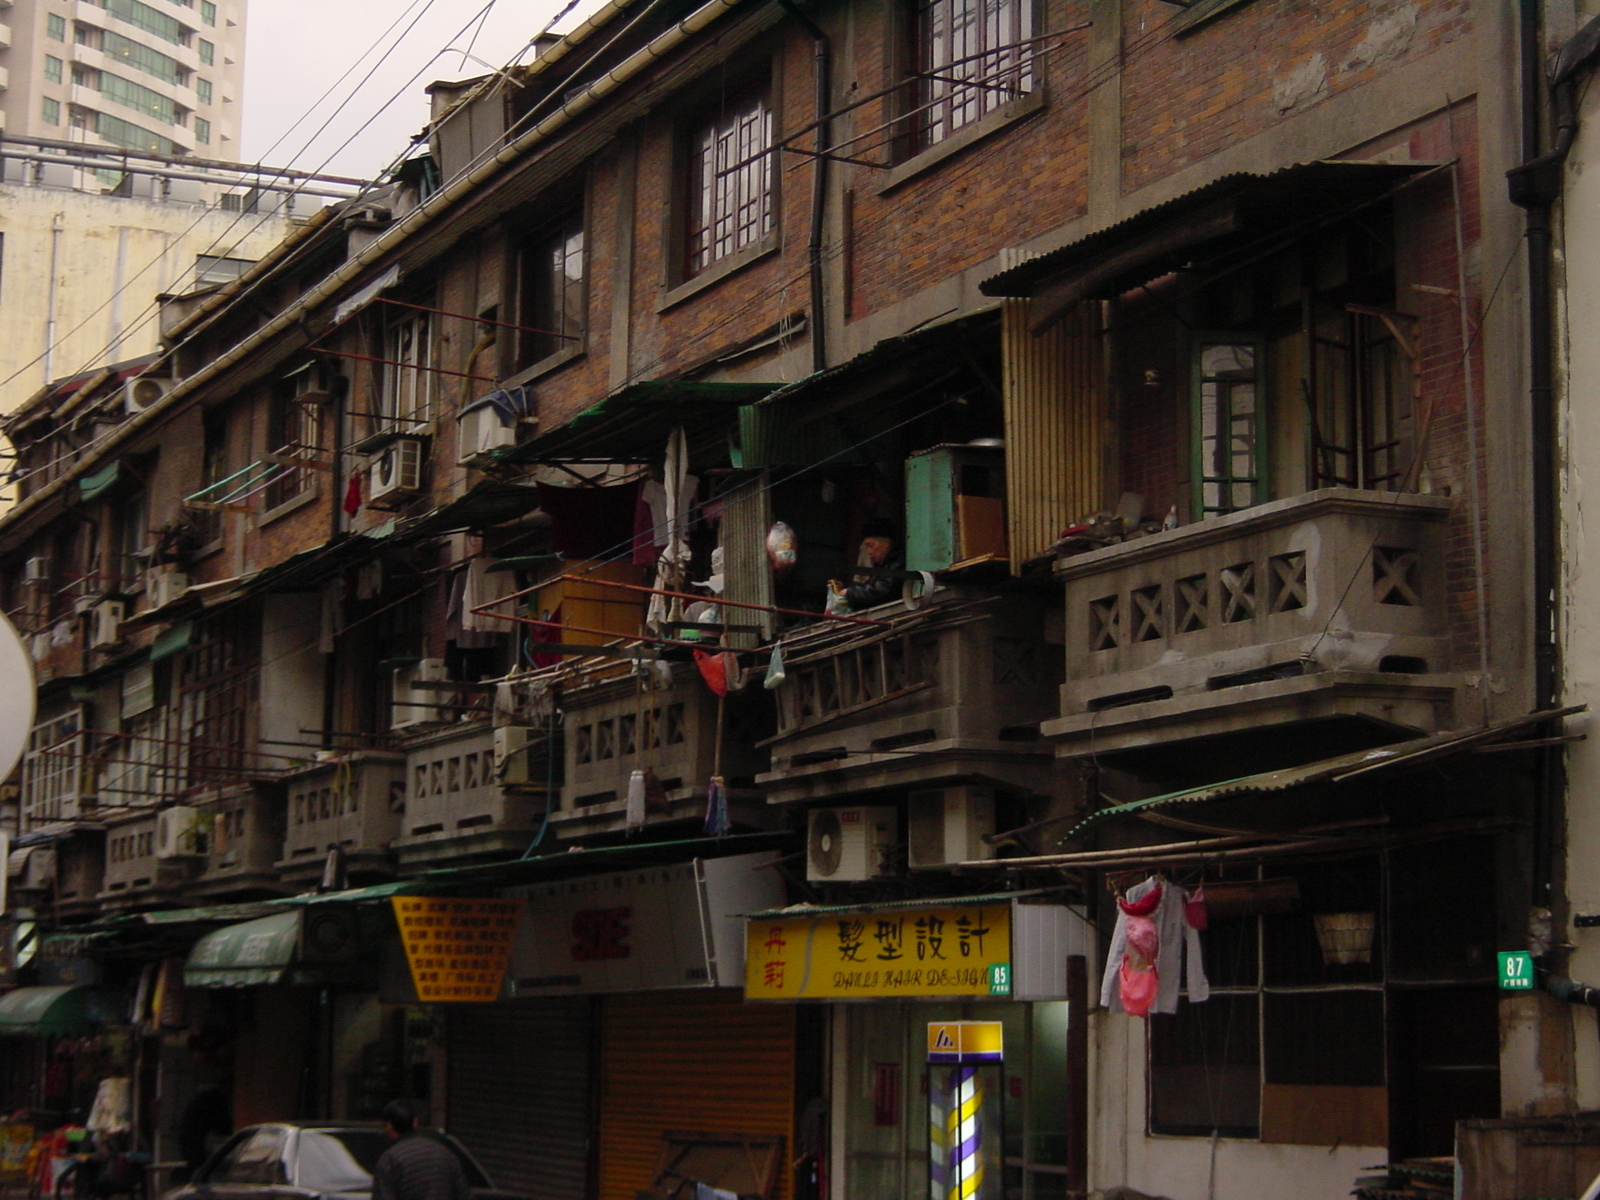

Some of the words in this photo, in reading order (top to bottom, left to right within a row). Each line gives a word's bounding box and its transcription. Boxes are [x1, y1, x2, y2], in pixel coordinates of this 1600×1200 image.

[837, 910, 990, 962] 髮型設計
[994, 966, 1006, 985] 85
[1506, 956, 1524, 977] 87
[833, 970, 879, 990] DANLI
[883, 968, 922, 989] HAIR
